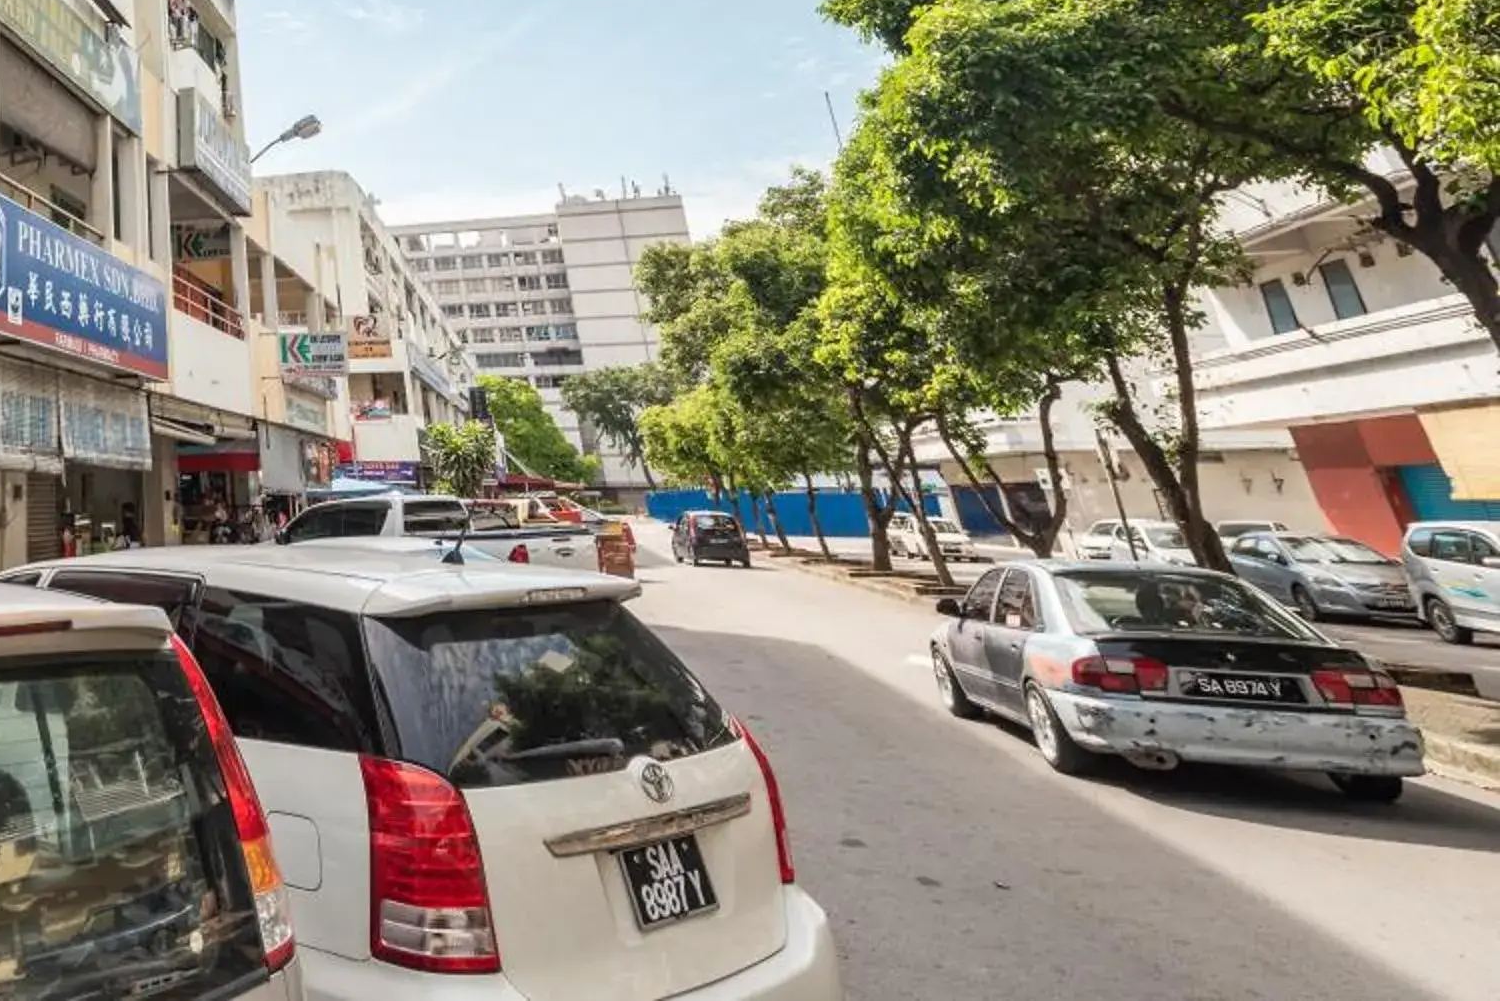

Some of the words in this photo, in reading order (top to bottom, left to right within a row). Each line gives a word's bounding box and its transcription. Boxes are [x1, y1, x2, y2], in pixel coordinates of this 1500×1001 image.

[18, 220, 100, 287] PHARMEX
[1198, 678, 1223, 695] SA
[1269, 678, 1282, 696] Y
[646, 841, 686, 881] SAA
